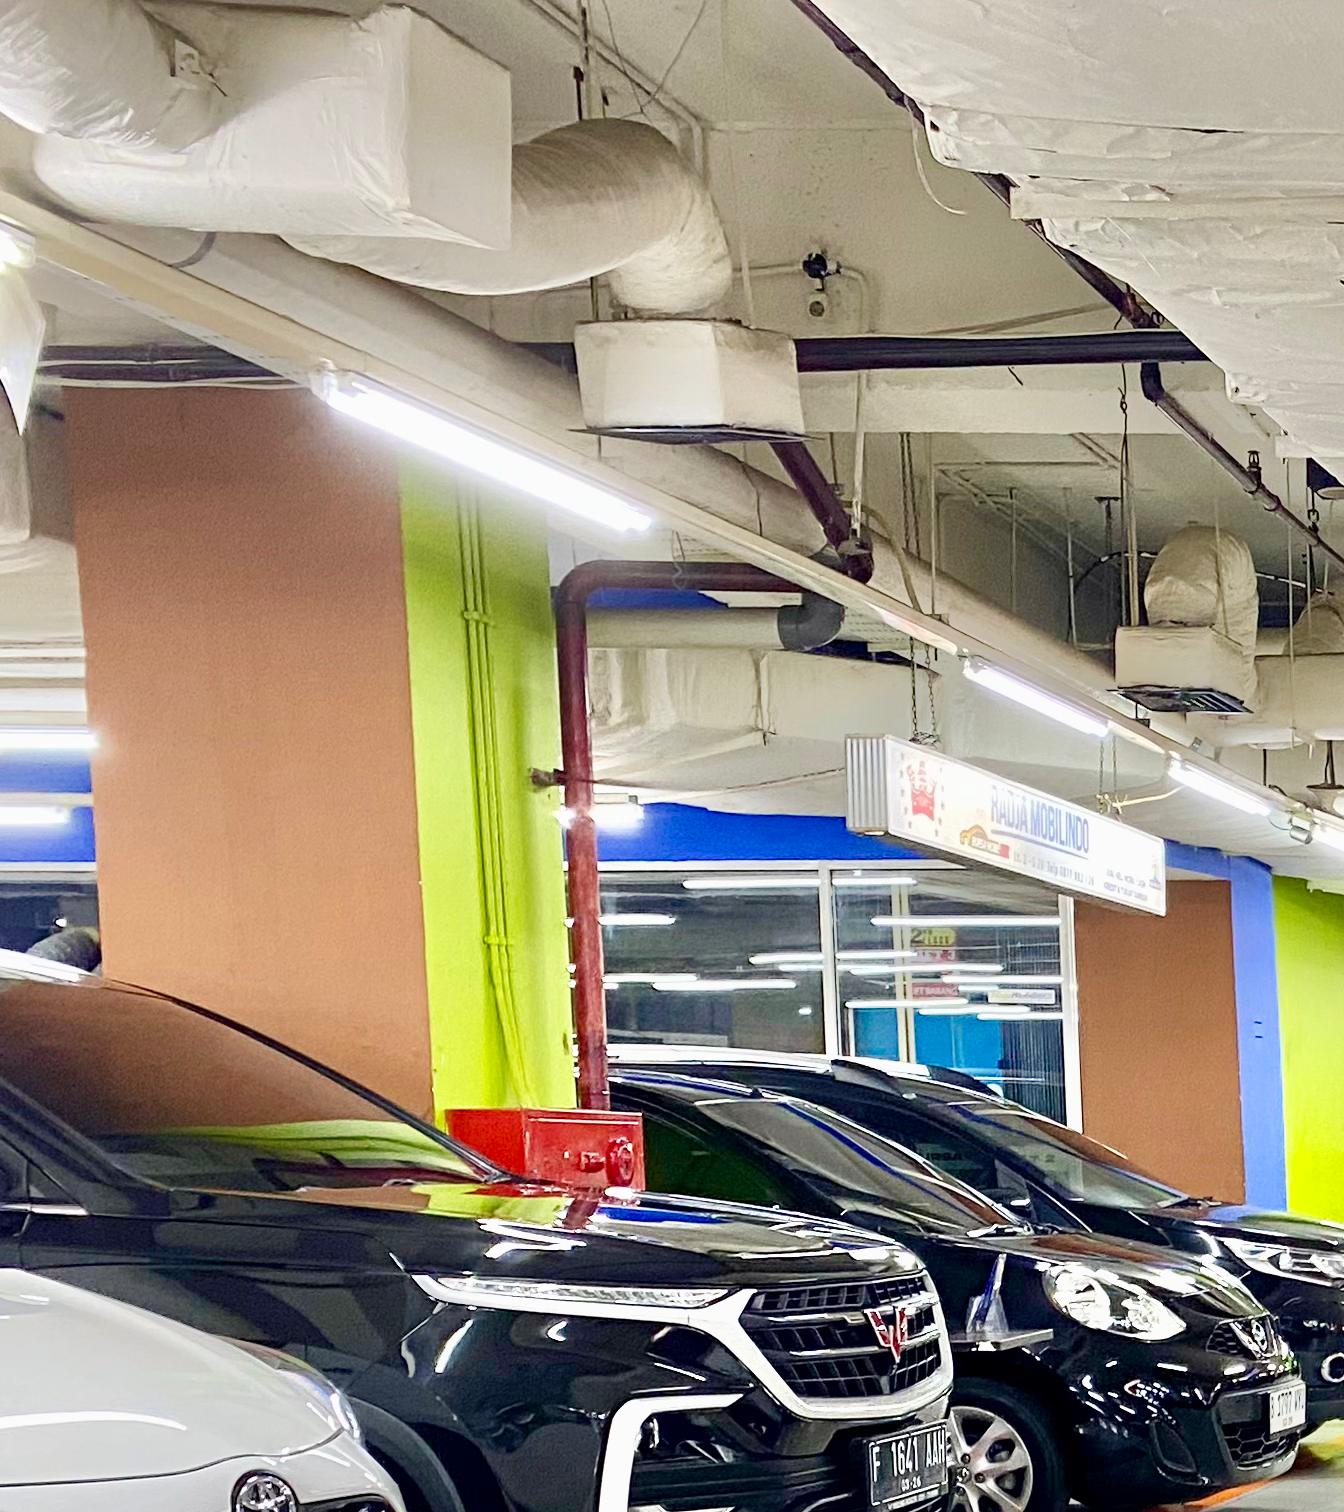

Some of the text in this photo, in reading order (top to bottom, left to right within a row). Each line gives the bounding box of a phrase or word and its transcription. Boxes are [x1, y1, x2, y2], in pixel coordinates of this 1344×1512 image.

[991, 785, 1089, 854] RADJA MOBILINDO
[872, 1429, 945, 1483] F 1641 AAH
